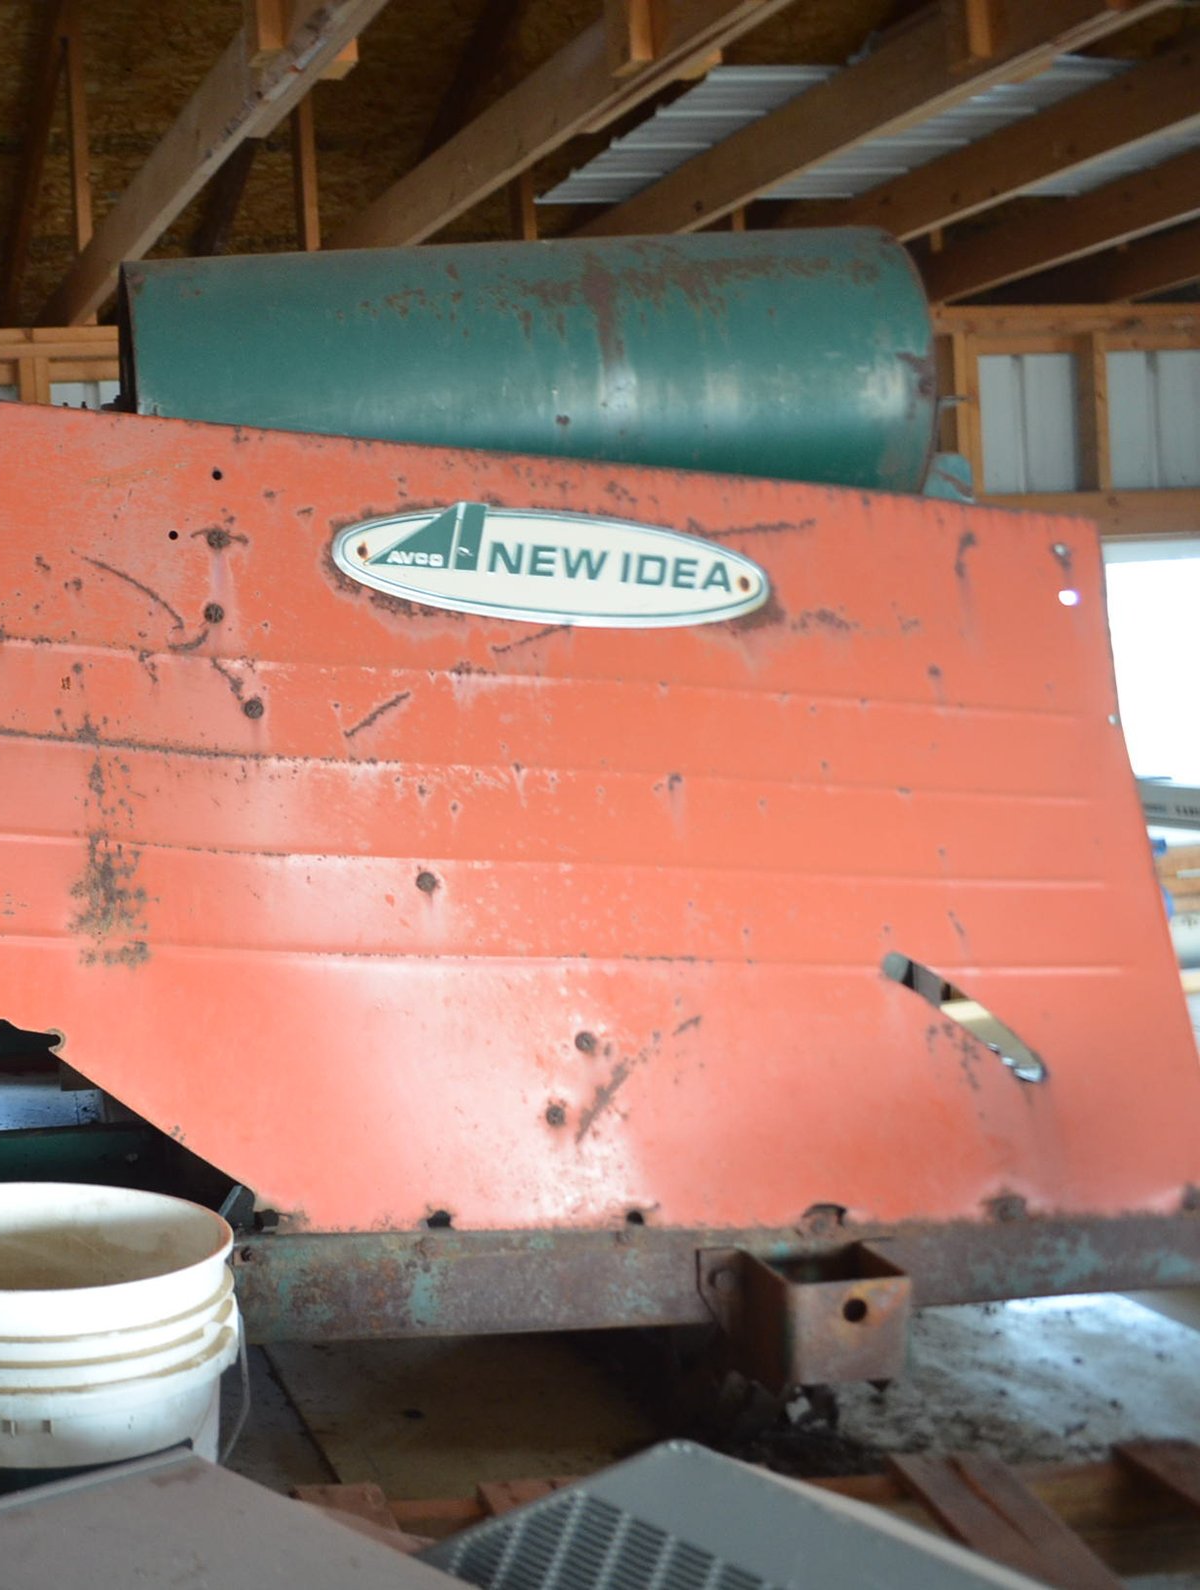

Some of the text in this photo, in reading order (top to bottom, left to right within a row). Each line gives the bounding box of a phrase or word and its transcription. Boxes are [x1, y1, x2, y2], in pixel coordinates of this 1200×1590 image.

[386, 550, 443, 567] AVCO
[488, 541, 732, 593] NEW IDEA
